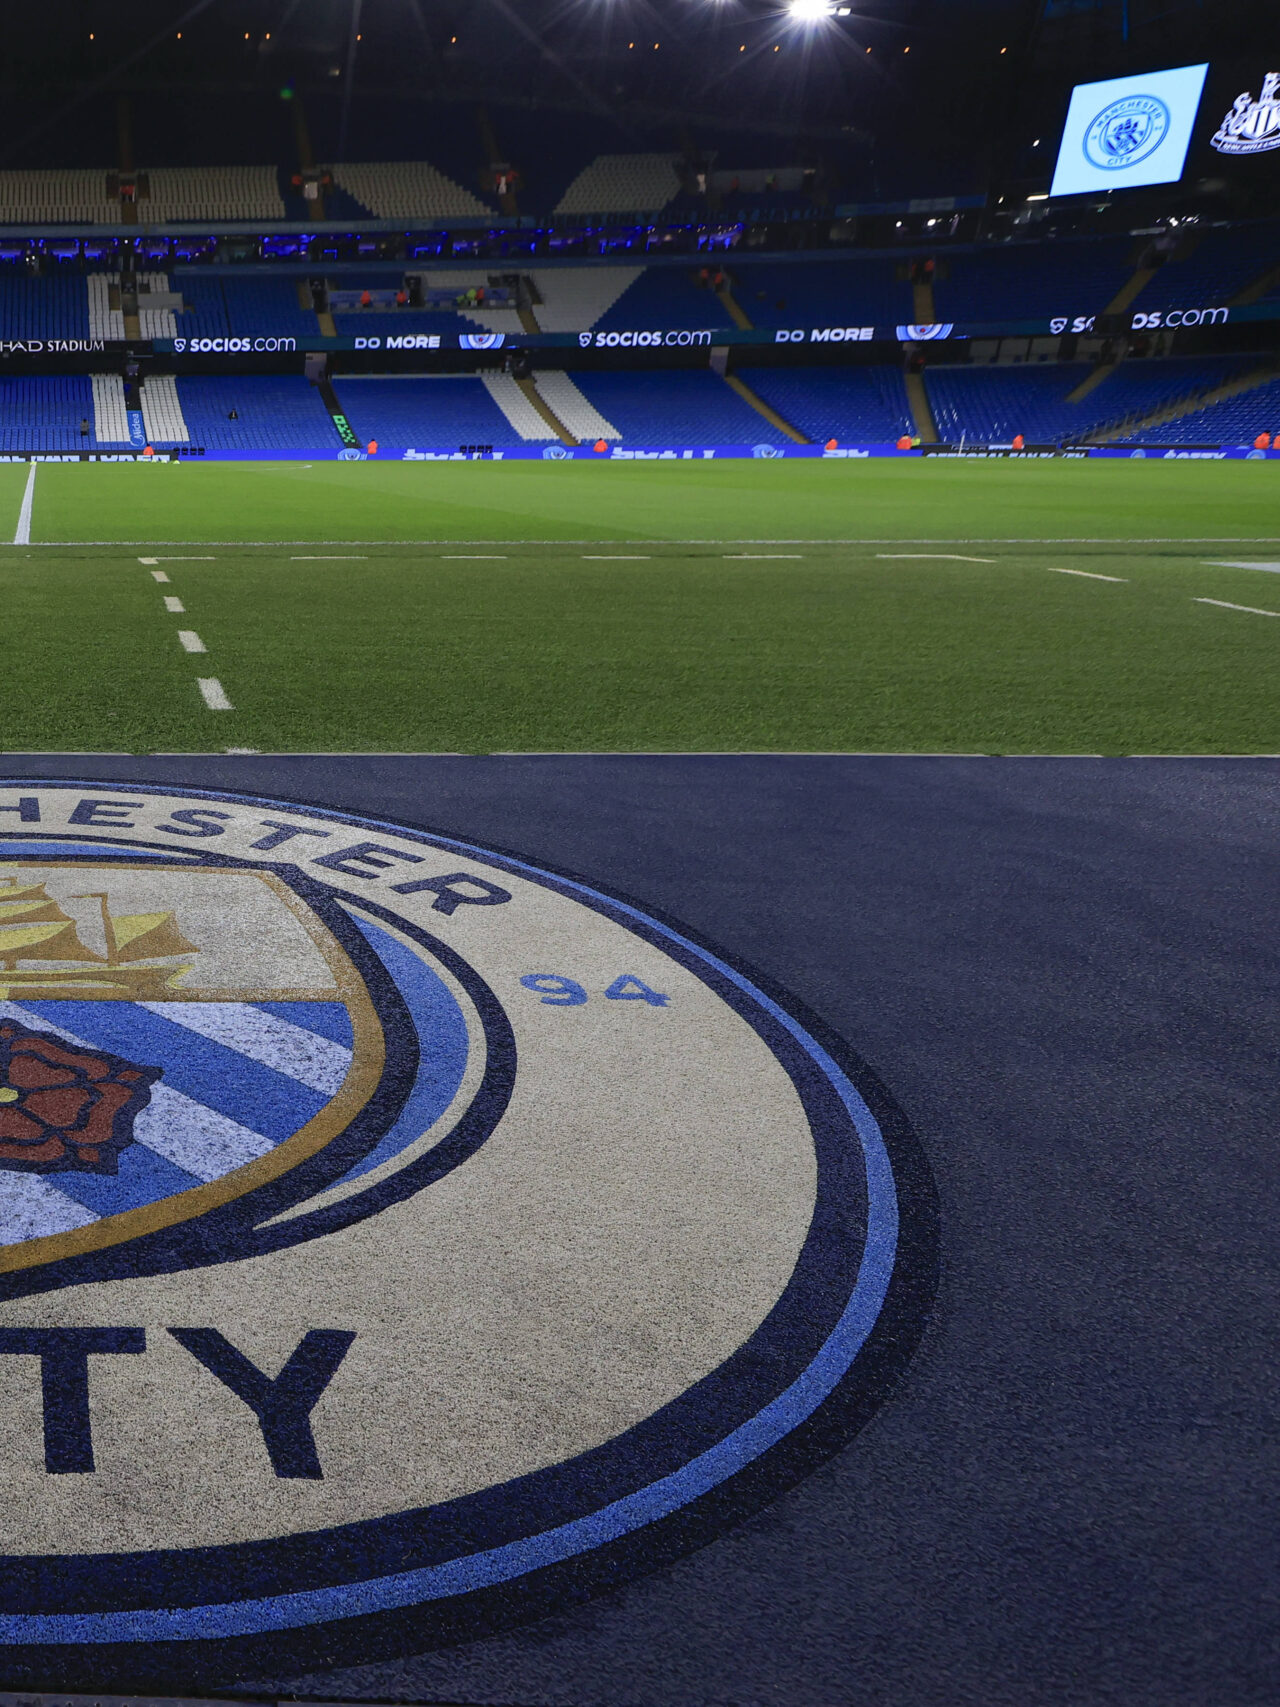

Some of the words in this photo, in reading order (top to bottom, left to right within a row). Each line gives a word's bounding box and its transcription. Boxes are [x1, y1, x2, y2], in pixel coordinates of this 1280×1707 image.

[1107, 156, 1132, 166] CITY
[354, 337, 380, 349] DO
[386, 335, 440, 349] MORE
[595, 331, 711, 348] SOCIOS.com
[775, 330, 804, 343] DO
[810, 327, 874, 342] MORE
[47, 340, 105, 352] STADIUM
[190, 338, 296, 352] SOCIOS.com
[520, 974, 672, 1007] 94
